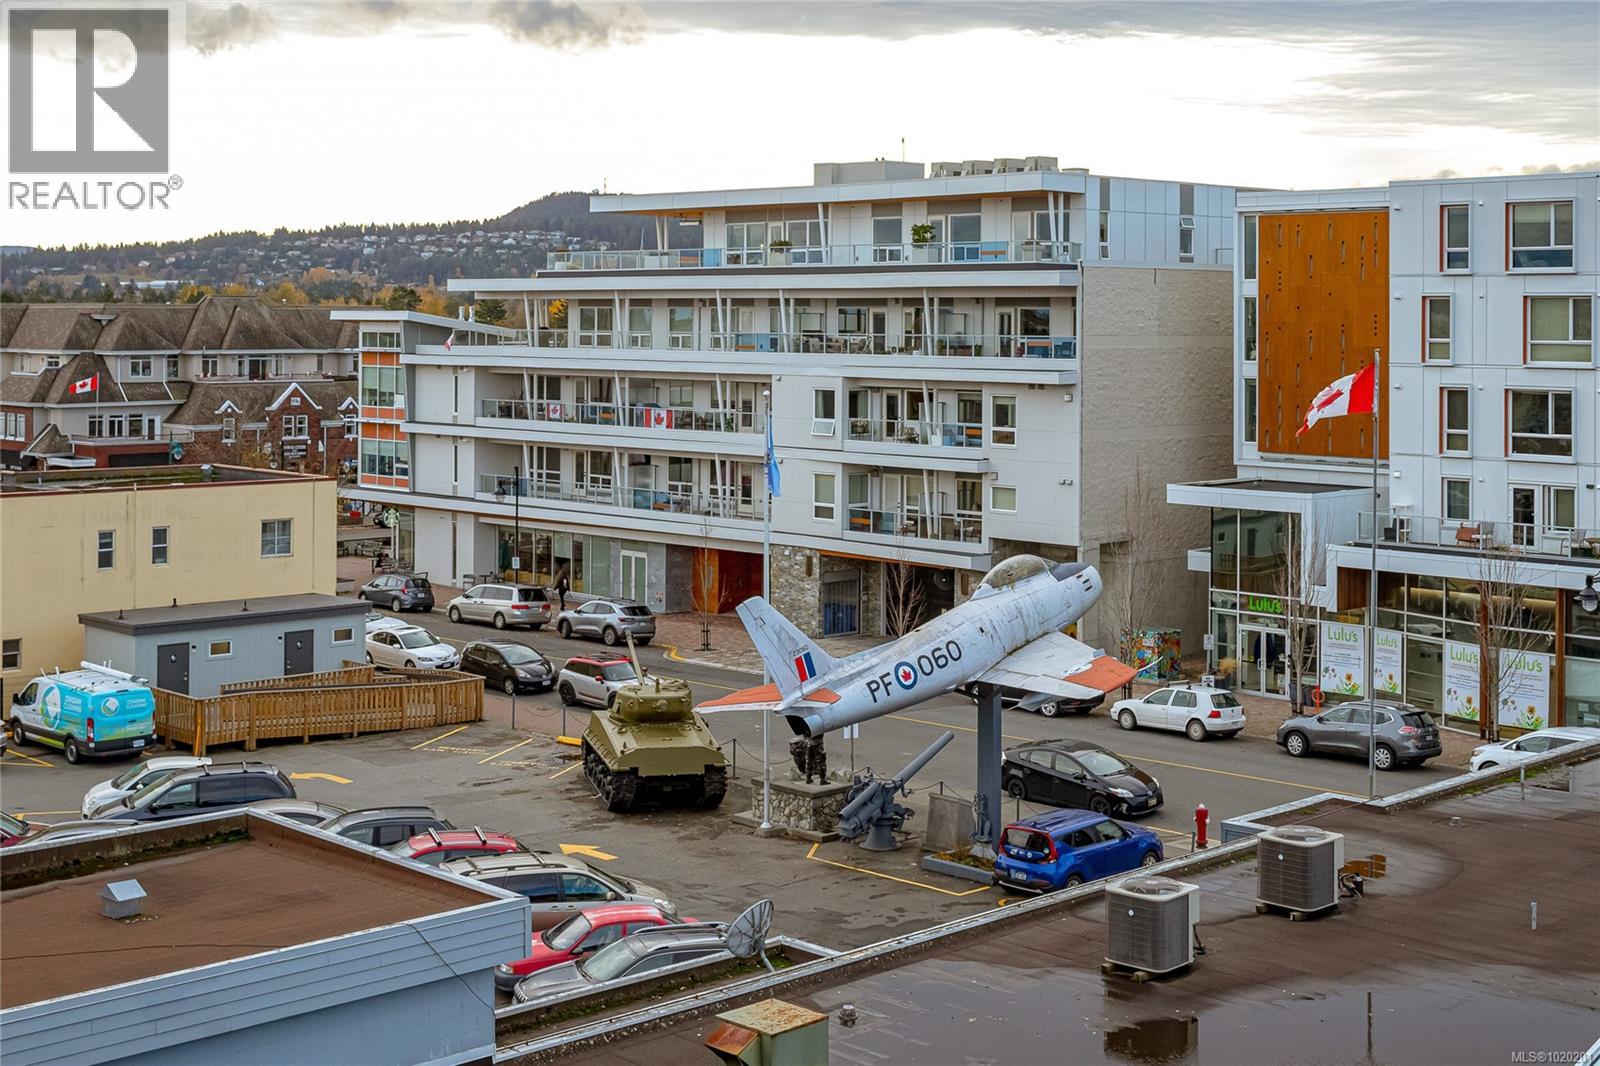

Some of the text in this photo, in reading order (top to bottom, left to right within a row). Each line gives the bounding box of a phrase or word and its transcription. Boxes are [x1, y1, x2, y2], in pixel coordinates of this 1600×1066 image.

[1327, 625, 1358, 642] Lulu's
[1450, 645, 1478, 664] Lulu's
[866, 640, 962, 704] PF 060
